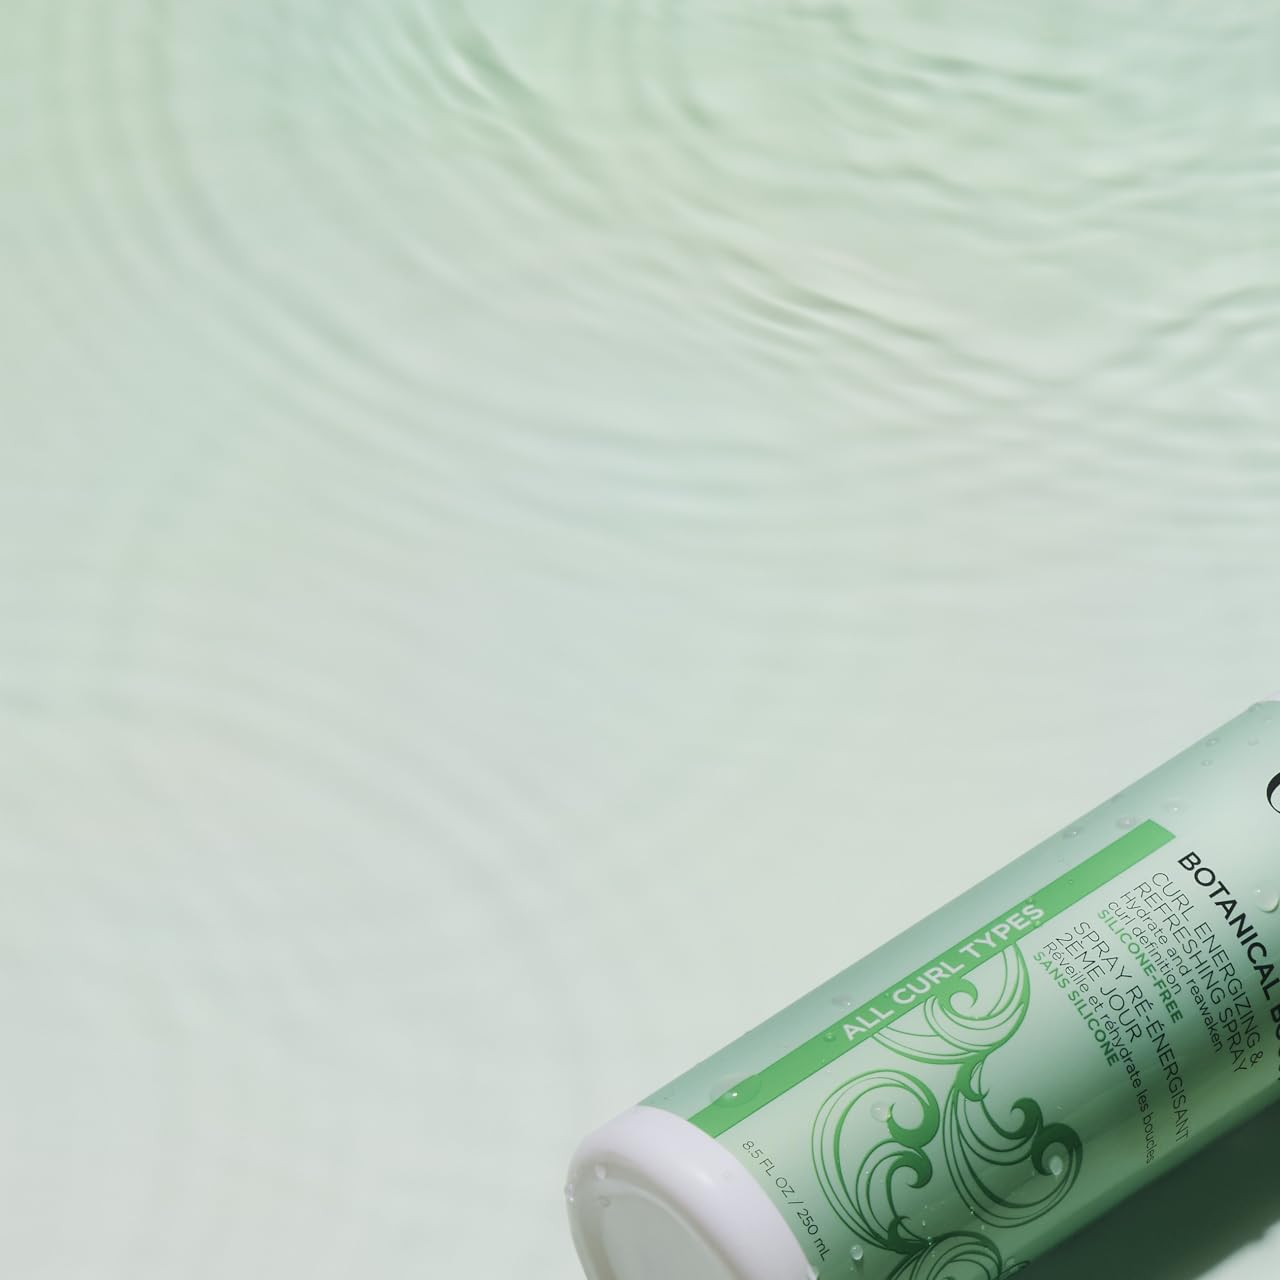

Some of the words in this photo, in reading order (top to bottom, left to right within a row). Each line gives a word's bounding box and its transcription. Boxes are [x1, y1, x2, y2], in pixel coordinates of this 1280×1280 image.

[842, 1007, 895, 1041] ALL
[891, 960, 965, 1005] CURL
[958, 903, 1045, 958] TYPES
[1043, 941, 1089, 993] Réveille
[1097, 909, 1184, 1024] SILICONE-FREE
[1108, 901, 1136, 926] curl
[1132, 926, 1182, 995] definition
[1120, 891, 1168, 945] Hydrate
[1166, 947, 1192, 977] and
[1186, 978, 1223, 1053] reawaken
[1133, 881, 1226, 1005] REFRESHING
[1218, 1007, 1248, 1073] SPRAY
[1152, 872, 1194, 922] CURL
[1193, 921, 1261, 1049] ENERGIZING
[1250, 1050, 1264, 1067] &
[1177, 851, 1280, 1000] BOTANICAL
[1033, 951, 1070, 990] SANS
[1067, 990, 1120, 1067] SILICONE
[1056, 932, 1106, 983] 2ÈME
[1100, 987, 1142, 1043] JOUR
[1073, 921, 1133, 981] SPRAY
[1125, 985, 1189, 1142] RÉ-ÉNERGISANT
[1088, 995, 1104, 1013] et
[1100, 1013, 1142, 1089] réhydrate
[1136, 1088, 1149, 1113] les
[1142, 1112, 1158, 1164] boucles
[742, 1140, 764, 1159] 8.5
[759, 1158, 775, 1177] FL
[775, 1176, 795, 1198] OZ
[796, 1208, 819, 1235] 250
[813, 1237, 830, 1262] mL
